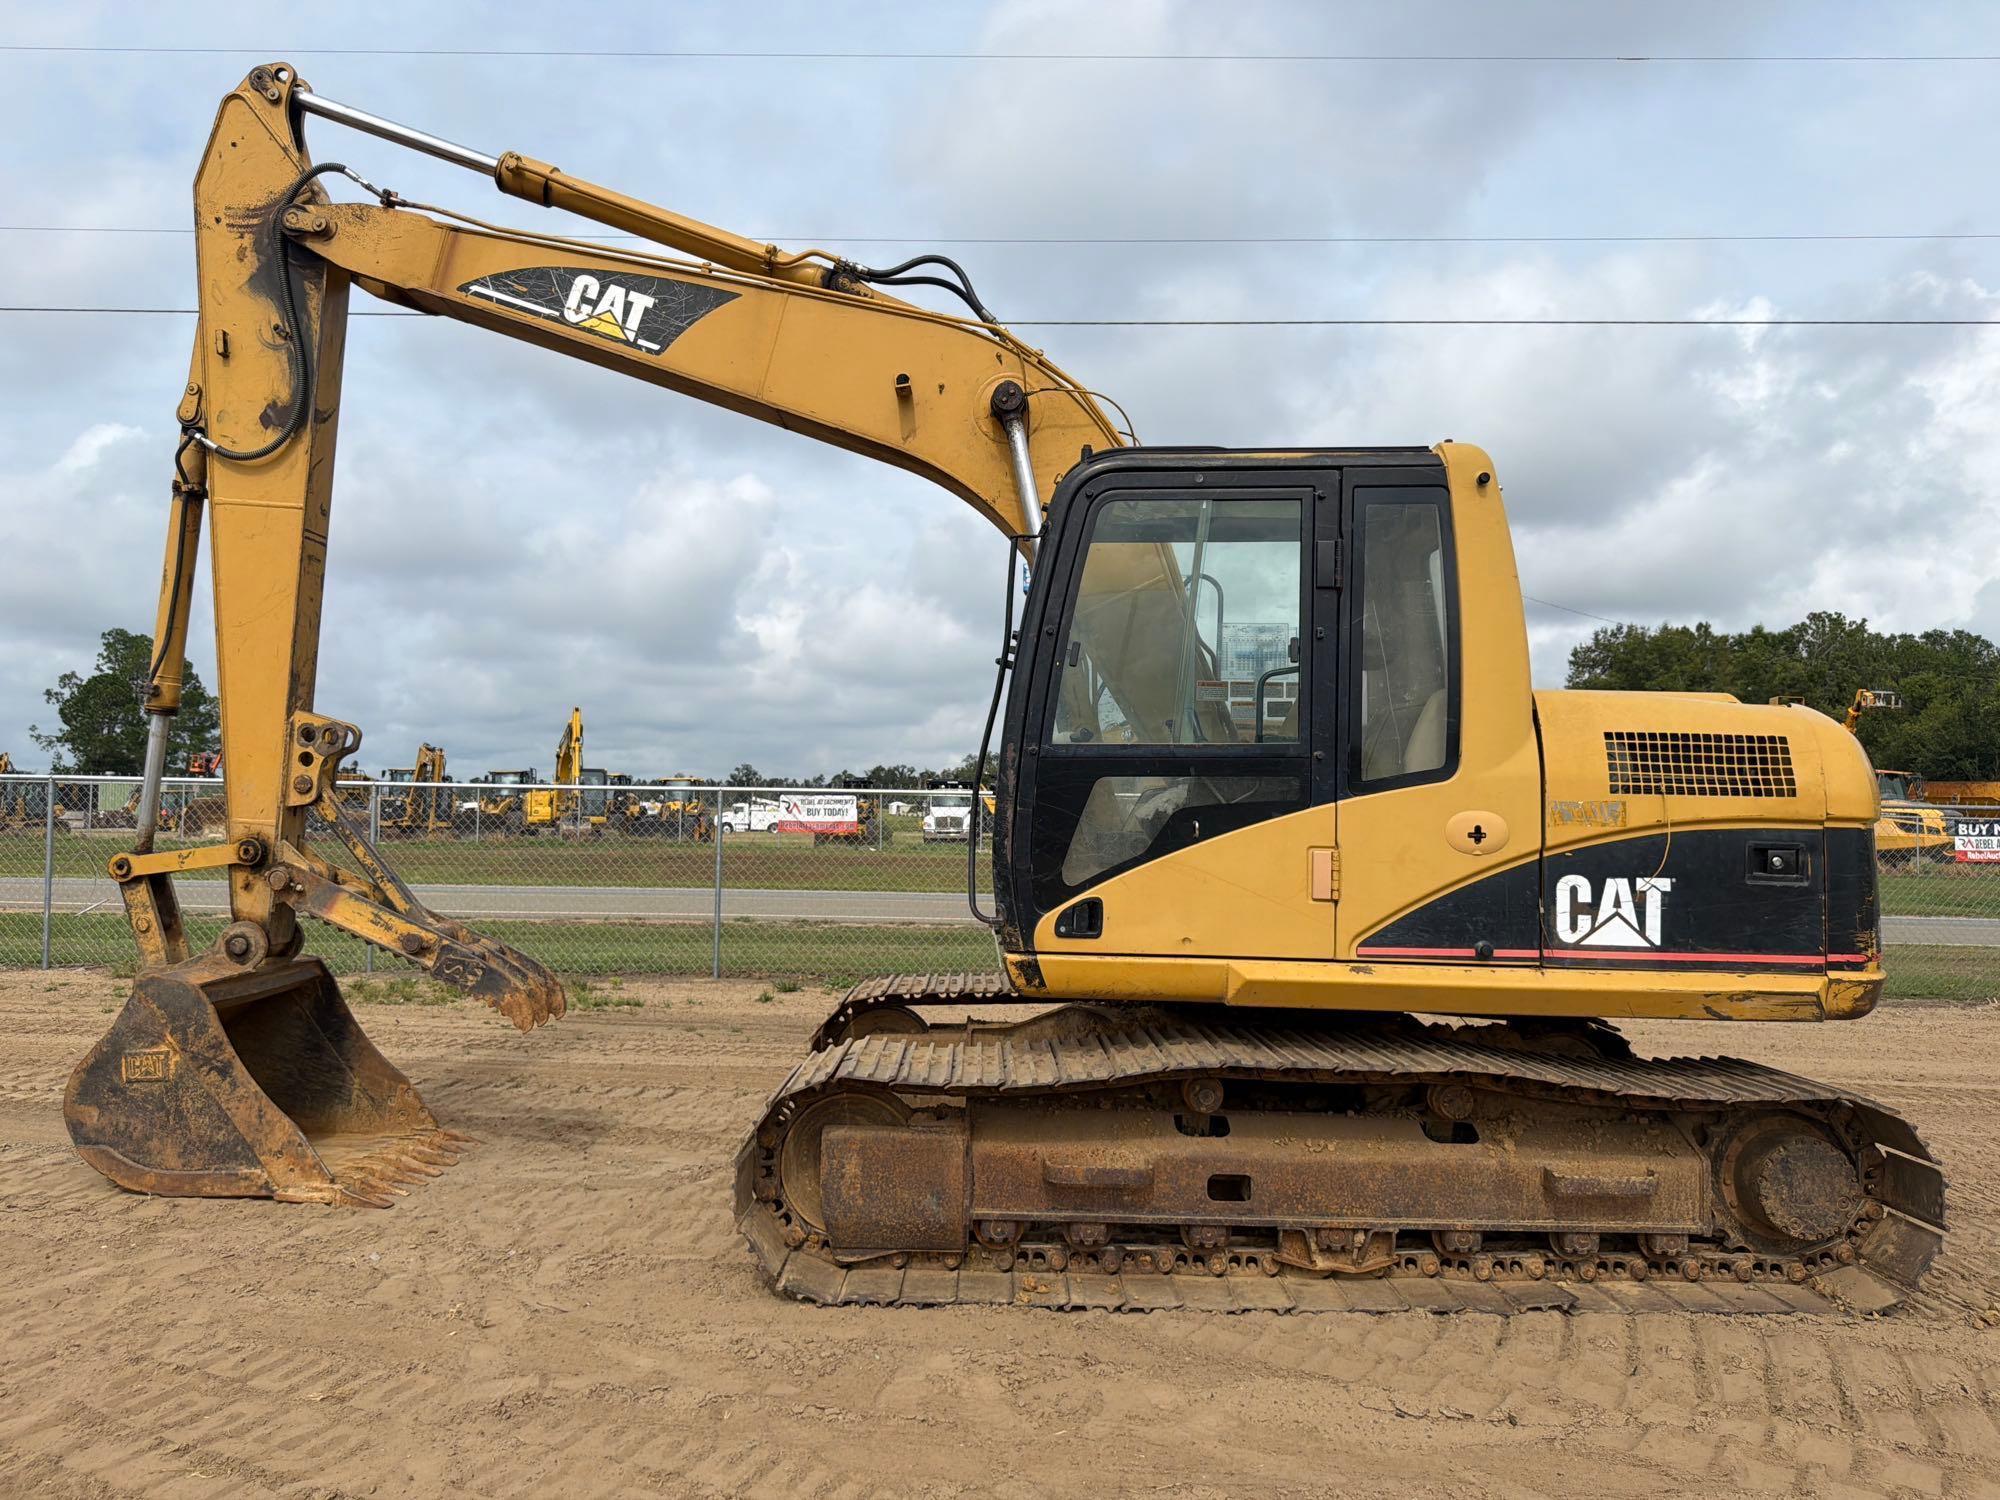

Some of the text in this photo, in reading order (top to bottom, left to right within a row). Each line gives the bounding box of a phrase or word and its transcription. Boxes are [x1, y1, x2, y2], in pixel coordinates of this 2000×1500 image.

[563, 274, 655, 343] CAT
[807, 808, 848, 816] BUY TODAY!
[1958, 824, 1989, 835] BUY
[1975, 839, 1994, 849] REBEL
[1556, 874, 1672, 947] CAT
[127, 1055, 164, 1079] CAT
